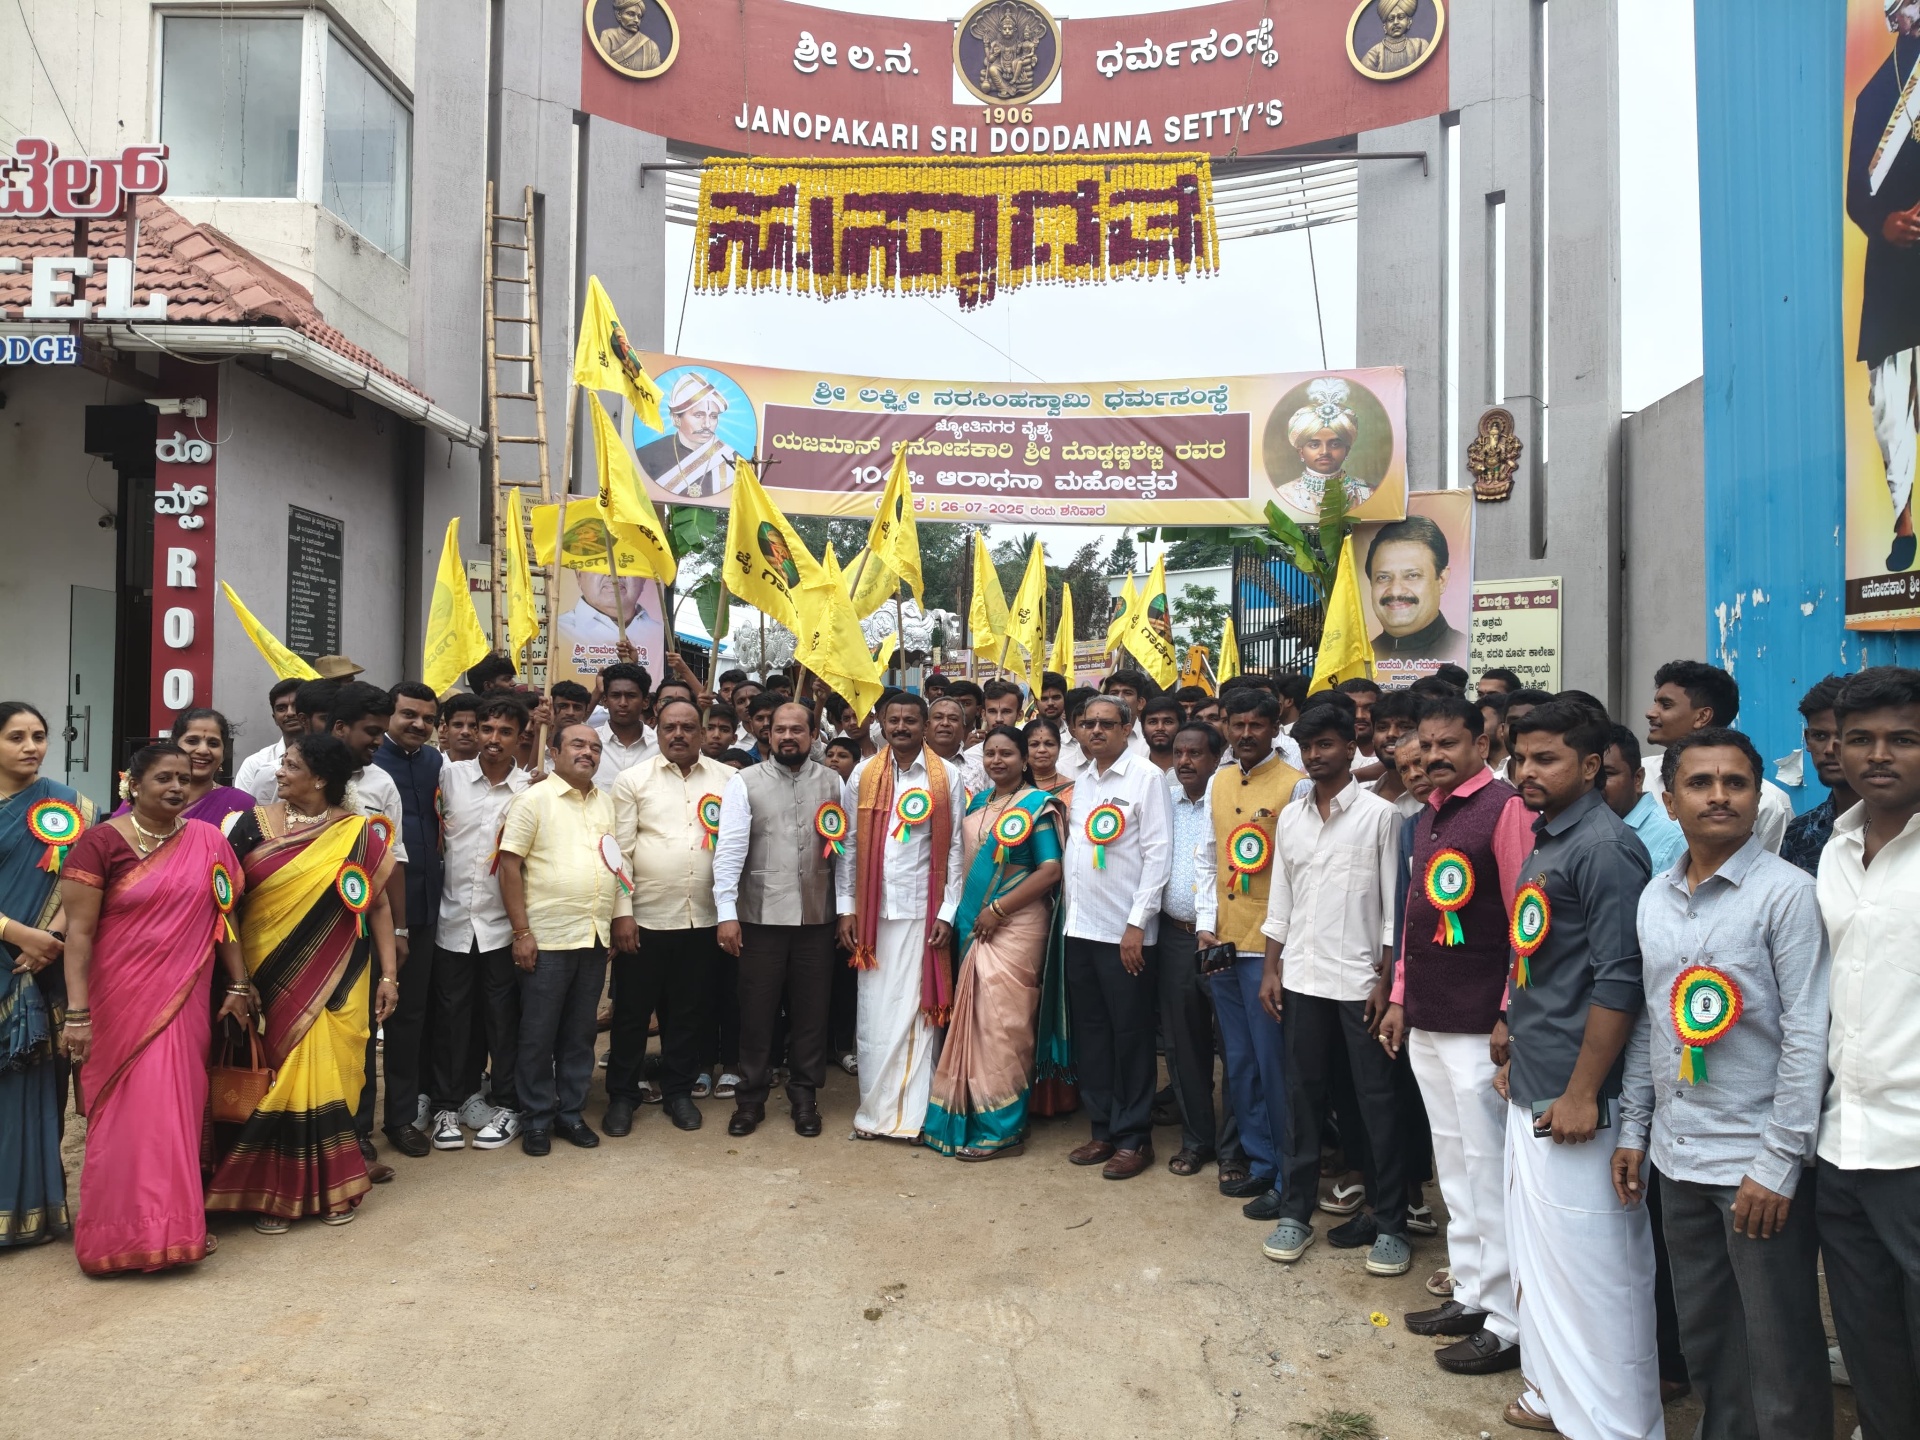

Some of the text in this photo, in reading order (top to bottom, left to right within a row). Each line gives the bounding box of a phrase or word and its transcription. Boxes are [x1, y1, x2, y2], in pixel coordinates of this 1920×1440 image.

[794, 31, 837, 73] ಶ್ರೀ
[1096, 18, 1279, 78] ಧರ್ಮಸಂಸ್ಥೆ
[735, 102, 918, 151] JANOPAKARI
[931, 125, 977, 153] SRI
[990, 119, 1152, 154] DODDANNA
[982, 107, 1034, 124] 1906
[0, 257, 168, 321] EL
[813, 382, 1229, 417] ಶ್ರೀ ಲಕ್ಷ್ಮೀ ನರಸಿಂಹಸ್ವಾಮಿ ಧರ್ಮಸಂಸ್ಥೆ
[772, 430, 881, 456] ಯಜಮಾನ್
[1023, 441, 1050, 467] ಶ್ರೀ
[1175, 439, 1226, 461] ರವರ
[935, 419, 1053, 443] ಜ್ಯೋತಿನಗರ ವೈಶ್ಯ
[936, 469, 1043, 493] ಆರಾಧನಾ
[1054, 470, 1178, 499] ಮಹೋತ್ಸವ
[941, 501, 1024, 514] 26-07-2025
[1060, 503, 1106, 517] ಶನಿವಾರ
[1861, 578, 1906, 599] ಜನೋಪಕಾರಿ
[163, 547, 198, 742] ROO
